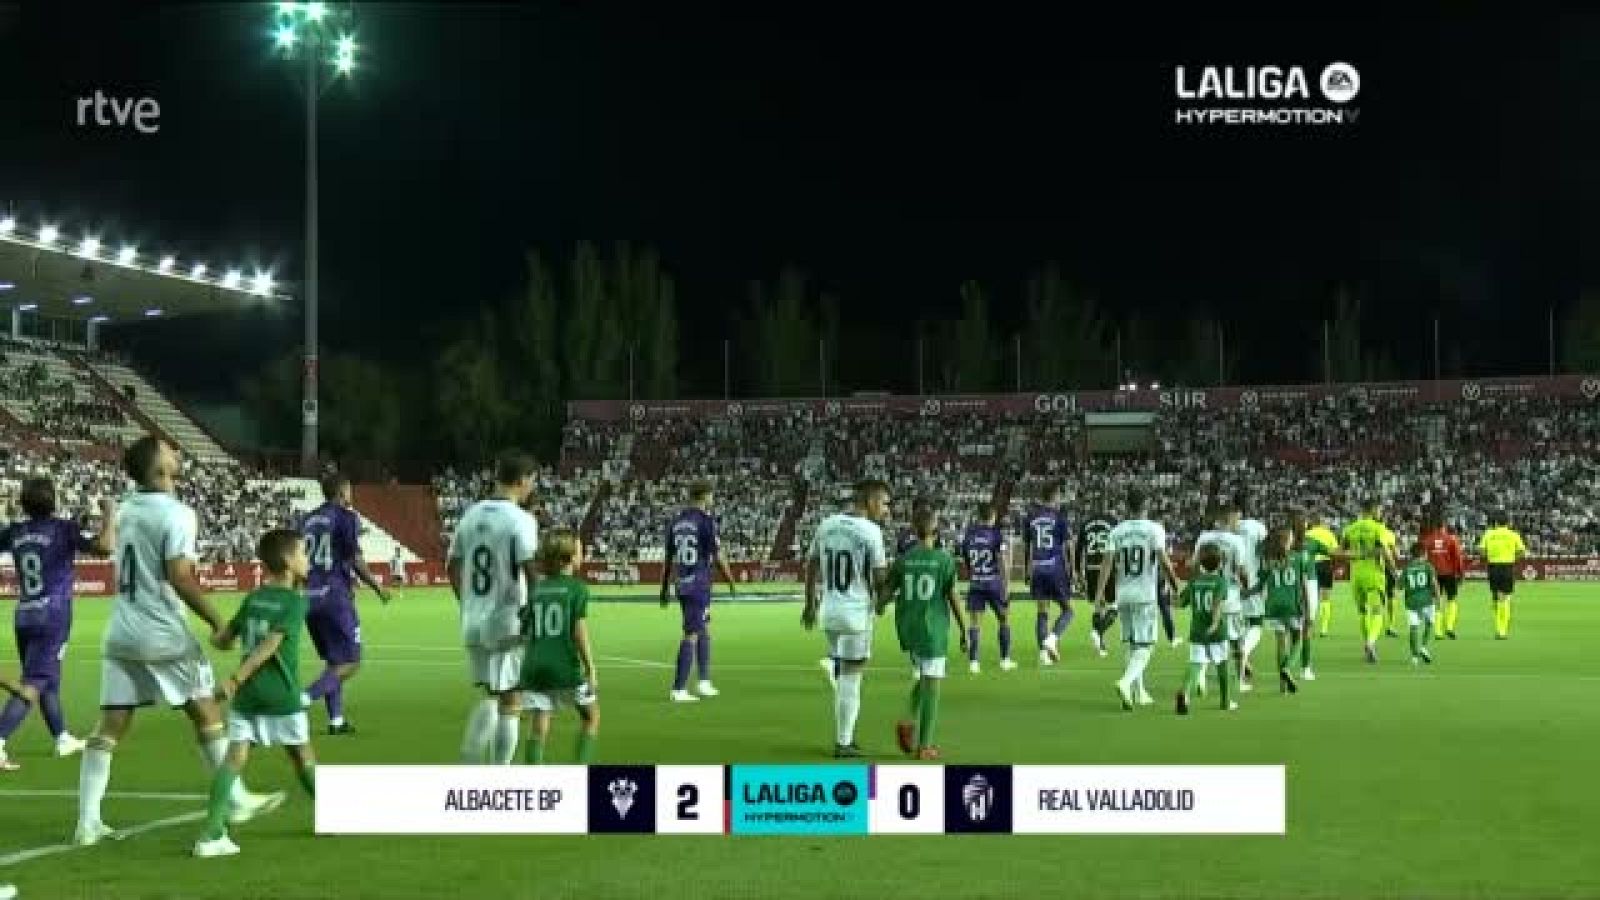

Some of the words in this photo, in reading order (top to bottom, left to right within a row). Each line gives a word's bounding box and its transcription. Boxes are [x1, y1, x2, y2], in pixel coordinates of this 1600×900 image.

[1035, 524, 1054, 549] 15
[19, 552, 43, 596] 8
[119, 543, 137, 602] 4
[472, 545, 493, 596] 8
[822, 550, 853, 594] 10
[969, 550, 994, 573] 22
[1123, 546, 1144, 577] 19
[901, 574, 935, 601] 10
[1272, 567, 1297, 589] 10
[1407, 572, 1428, 589] 10
[1194, 588, 1213, 612] 10
[533, 603, 563, 638] 10
